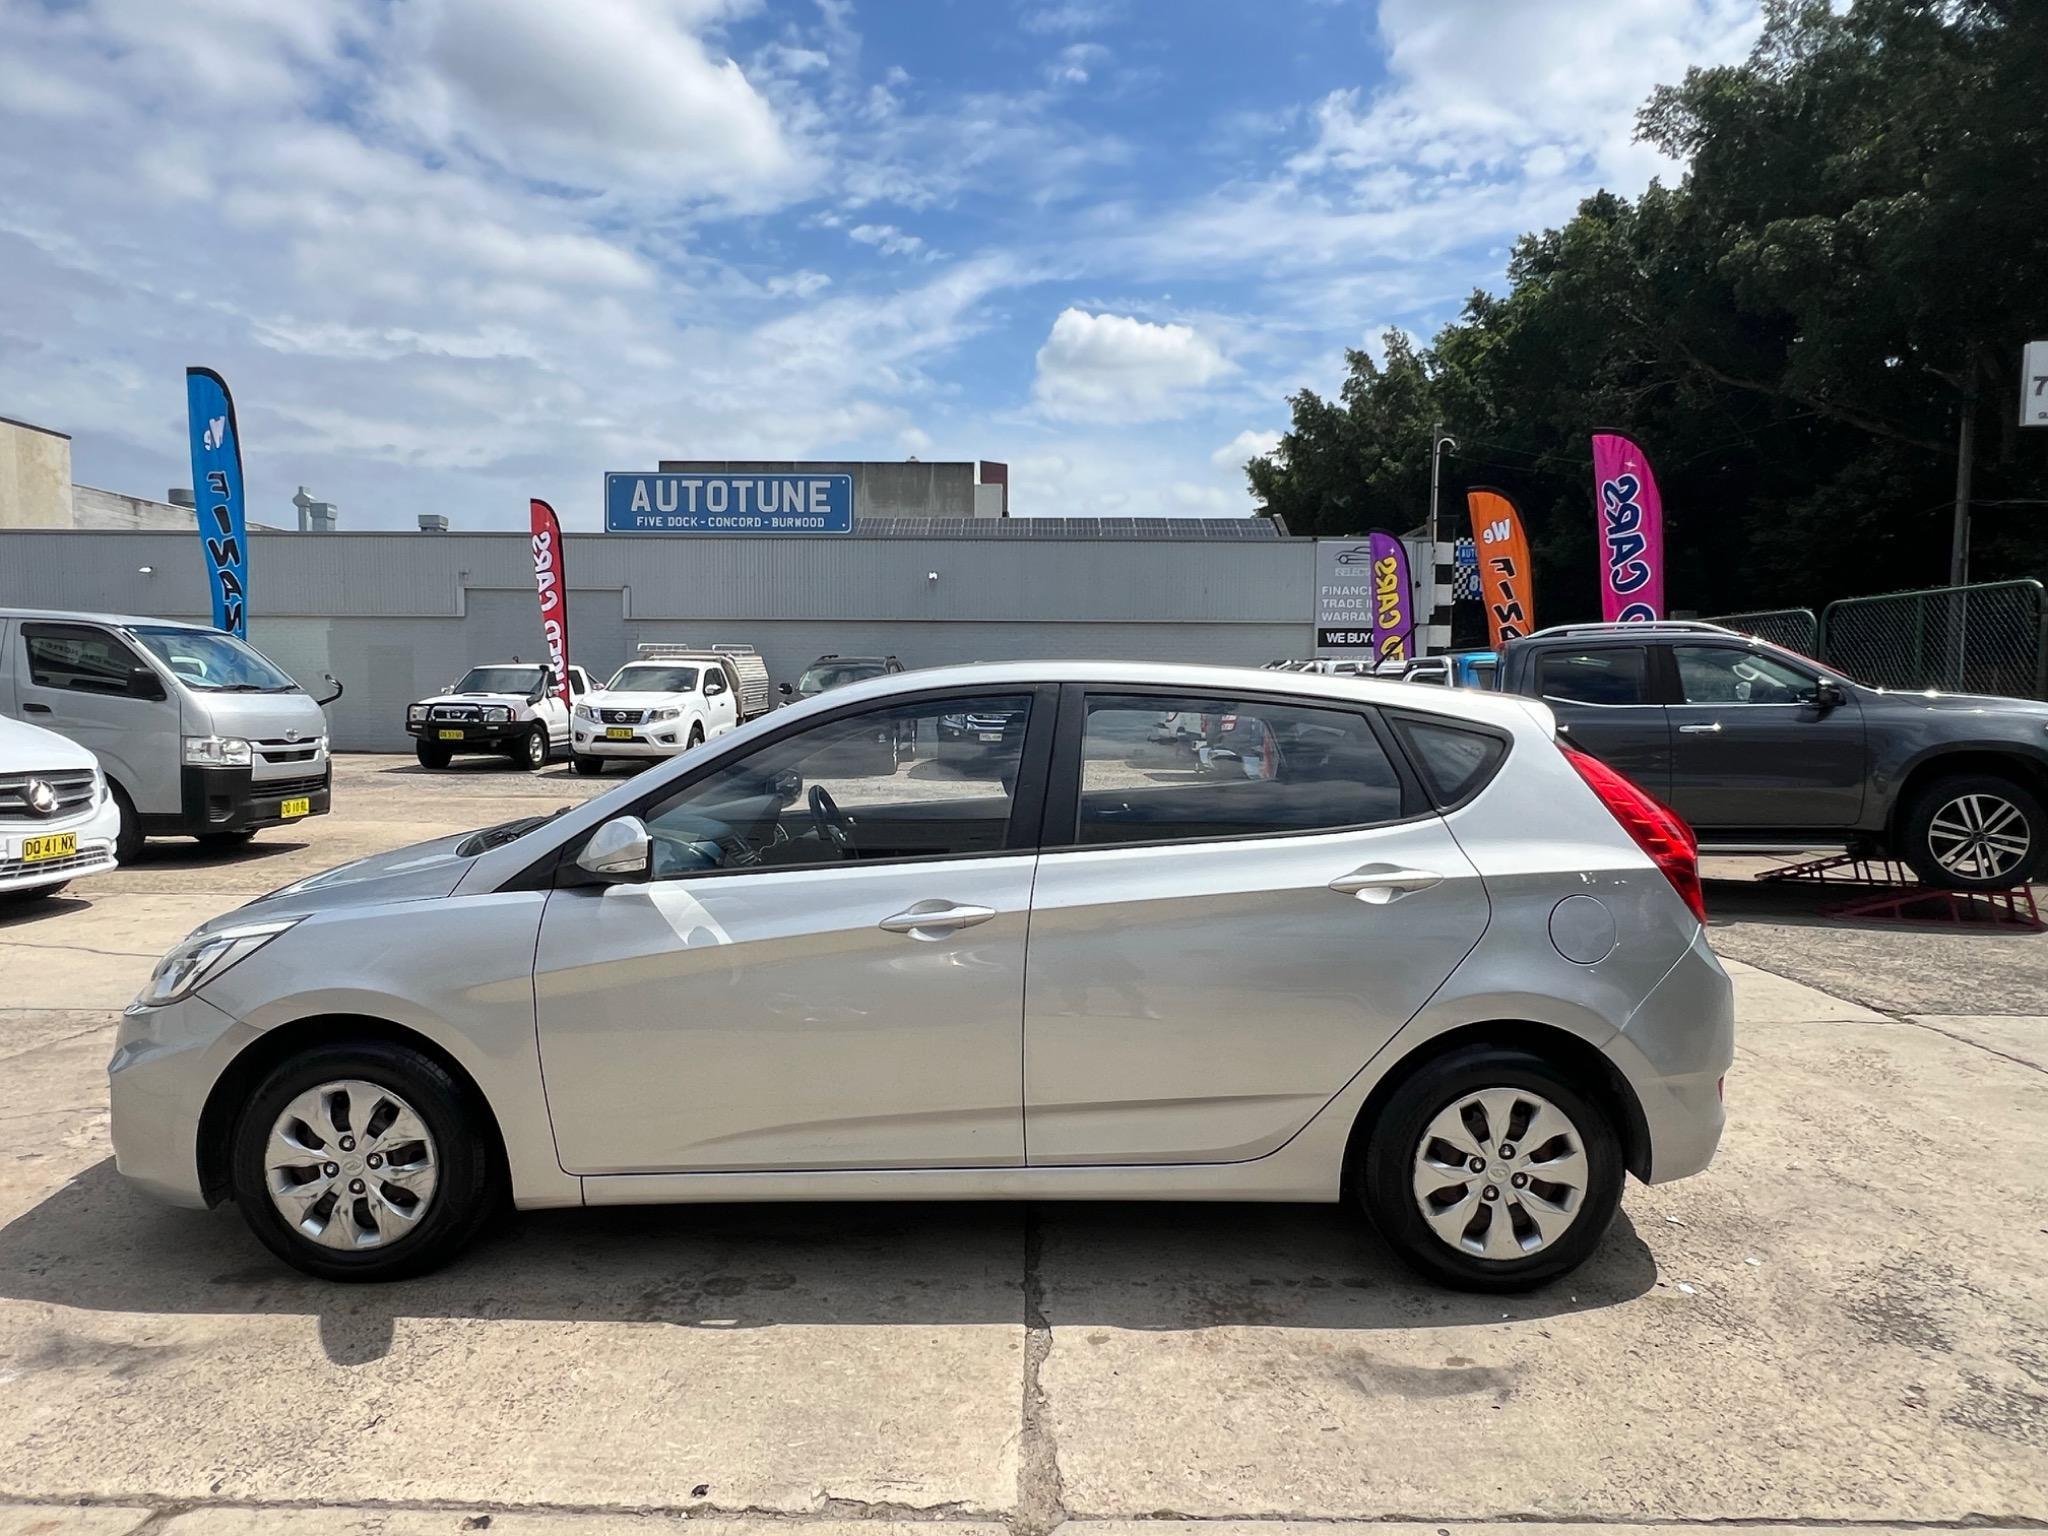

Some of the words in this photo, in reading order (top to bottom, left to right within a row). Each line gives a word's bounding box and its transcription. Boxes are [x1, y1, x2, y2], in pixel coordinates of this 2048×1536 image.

[630, 479, 832, 513] AUTOTUNE
[636, 516, 664, 527] FIVE
[667, 516, 698, 527] DOCK
[708, 516, 762, 528] CONCORD
[771, 517, 825, 528] BURWOOD
[1321, 599, 1362, 609] TRADE
[1326, 632, 1345, 644] WE
[1347, 632, 1371, 644] BUY
